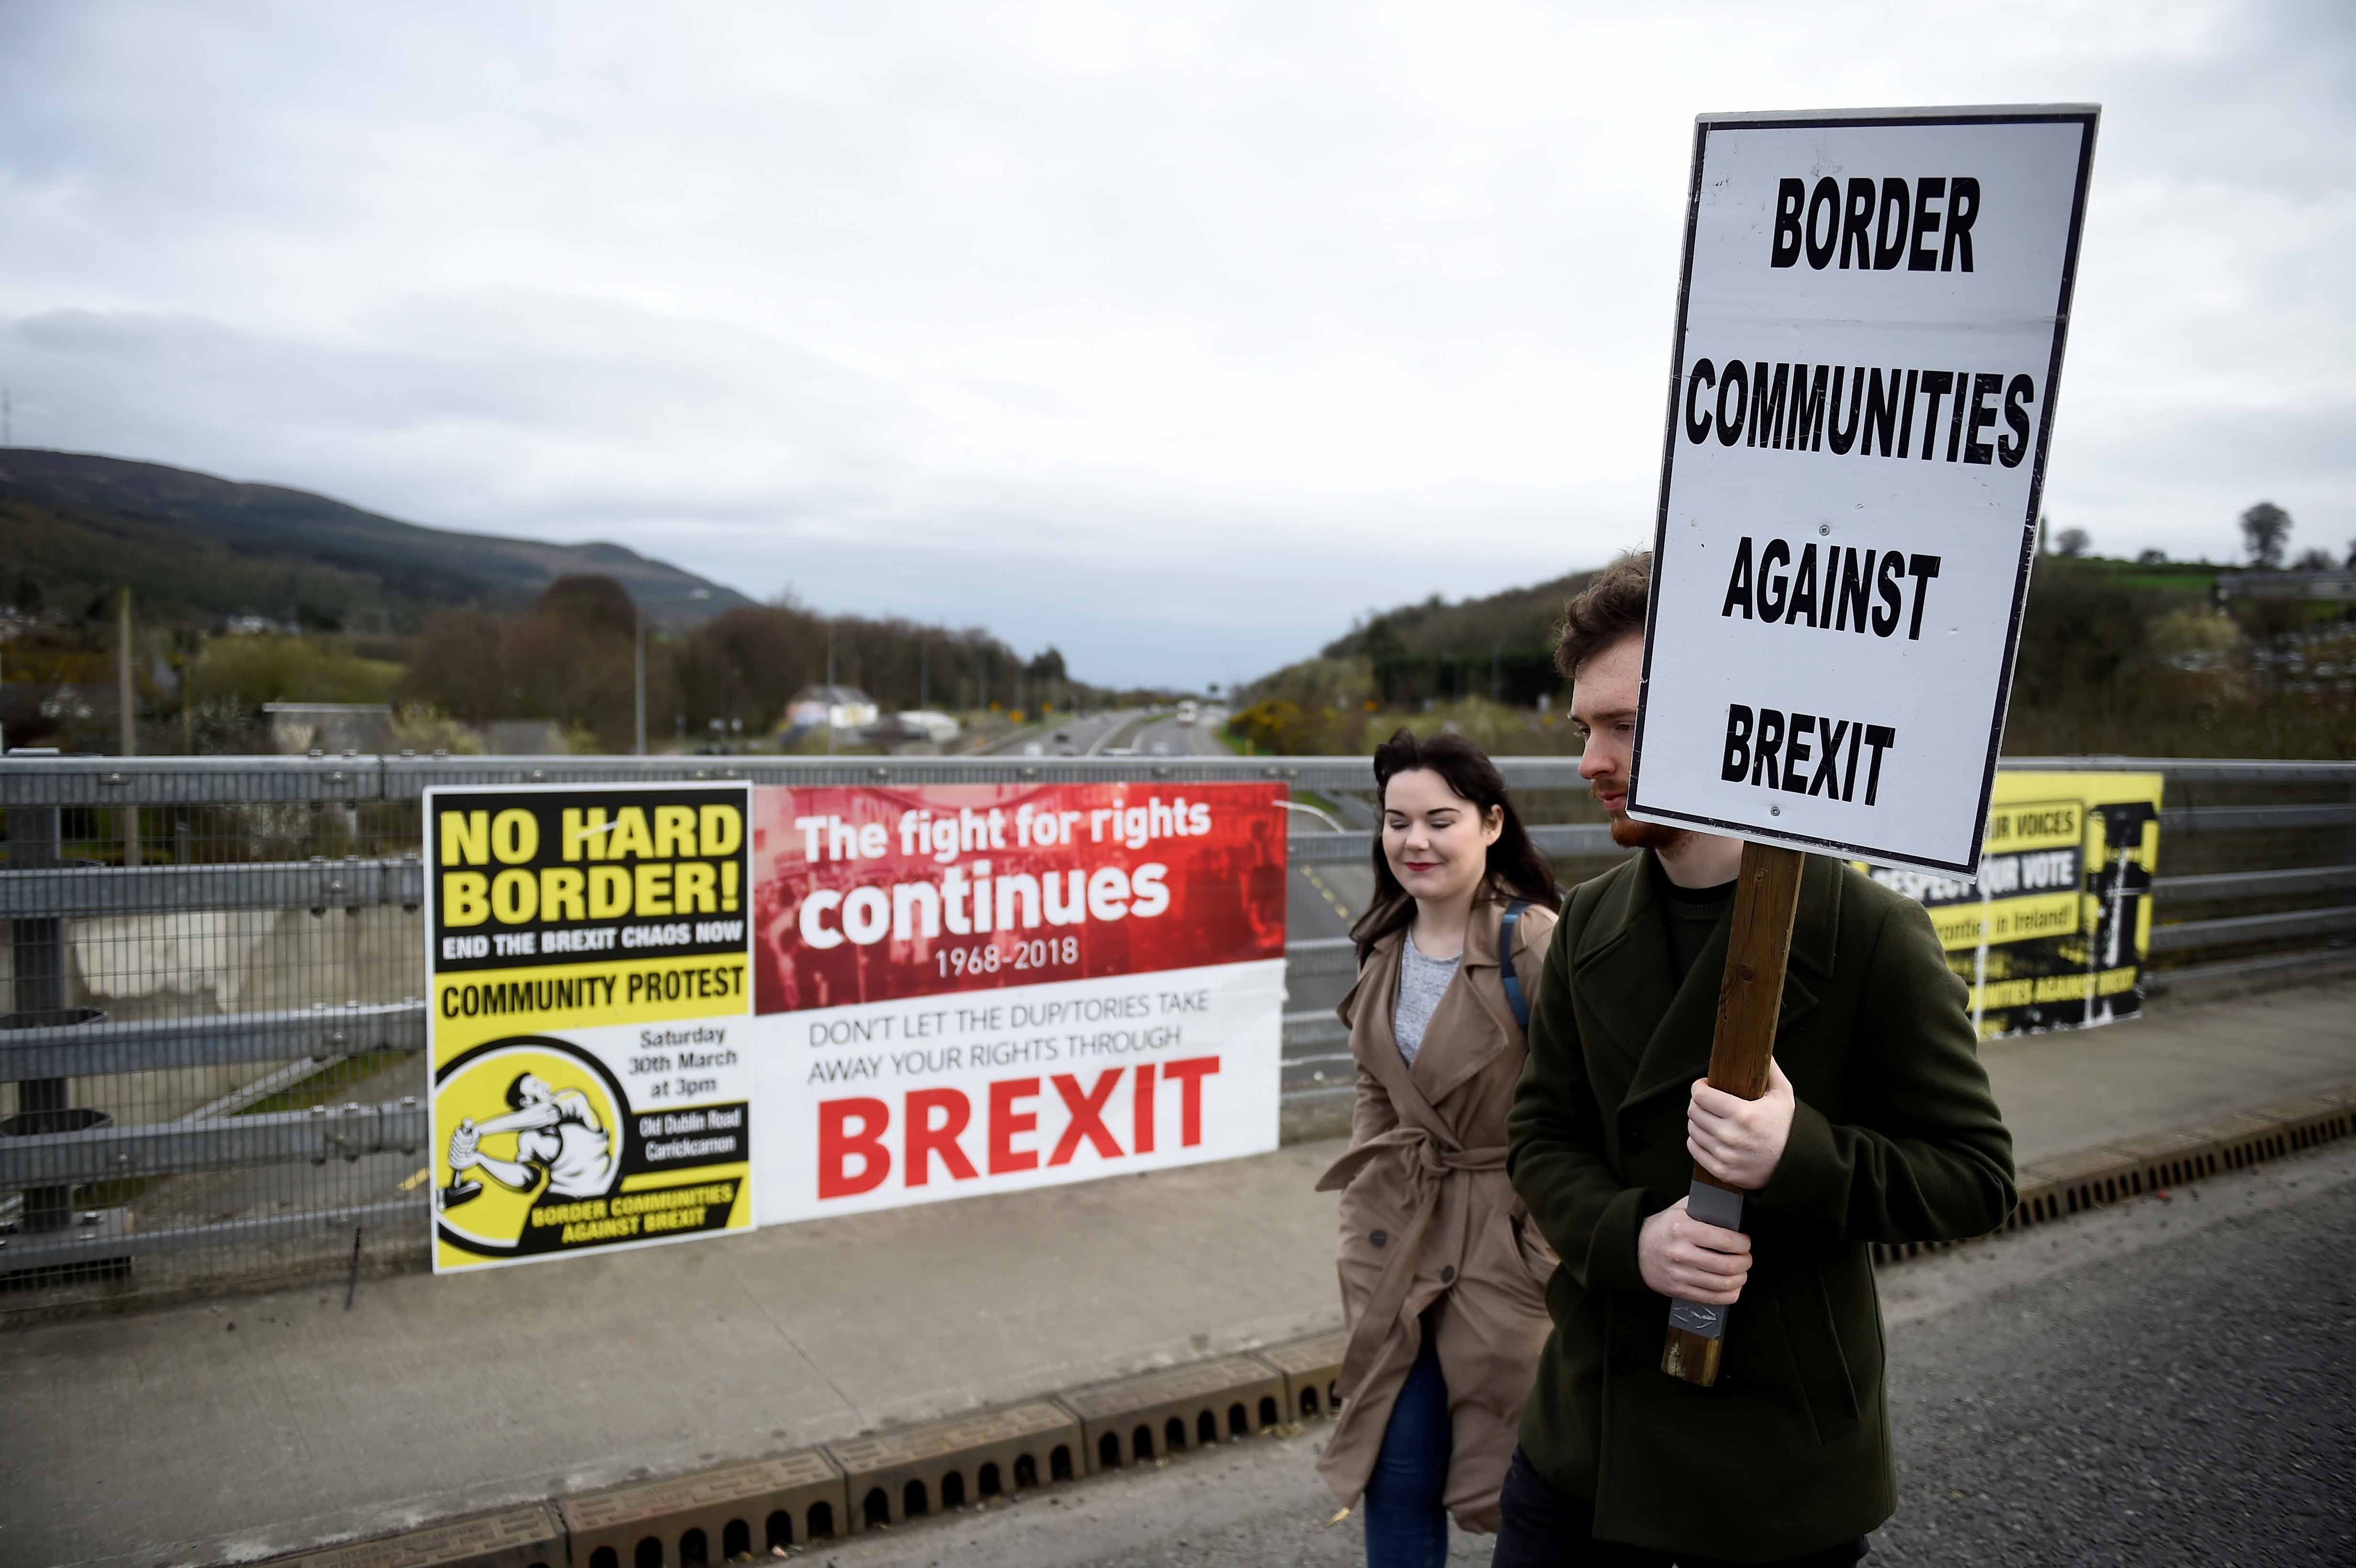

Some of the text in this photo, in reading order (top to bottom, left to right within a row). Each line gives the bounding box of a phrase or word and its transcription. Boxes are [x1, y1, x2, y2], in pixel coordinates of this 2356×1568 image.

[1770, 176, 1980, 272] BORDER
[1685, 358, 2034, 468] COMMUNITIES
[1722, 536, 1942, 641] AGAINST
[1721, 704, 1896, 806] BREXIT
[441, 805, 742, 867] NO HARD
[795, 815, 888, 863] The
[900, 807, 1005, 863] fight
[1016, 803, 1081, 848] for
[1091, 796, 1211, 849] rights
[2017, 811, 2073, 836] VOICES
[443, 861, 740, 927] BORDER!
[1977, 856, 2018, 893] OUR
[2022, 851, 2073, 888] VOTE
[799, 861, 1170, 949] continues
[443, 920, 744, 959] END THE BREXIT CHAOS NOW
[935, 936, 1079, 978] 1968-2018
[442, 967, 744, 1019] COMMUNITY PROTEST
[809, 989, 1209, 1047] DON'T LET THE DUP/TORIES TAKE
[629, 1047, 737, 1075] 30th March
[640, 1027, 726, 1048] Saturday
[807, 1025, 1181, 1086] AWAY YOUR RIGHTS THROUGH
[651, 1078, 716, 1097] at 3pm
[639, 1107, 742, 1137] Old Dublin Road
[817, 1055, 1220, 1201] BREXIT
[531, 1183, 734, 1228] BORDER COMMUNITIES
[561, 1206, 706, 1243] AGAINST BREXIT
